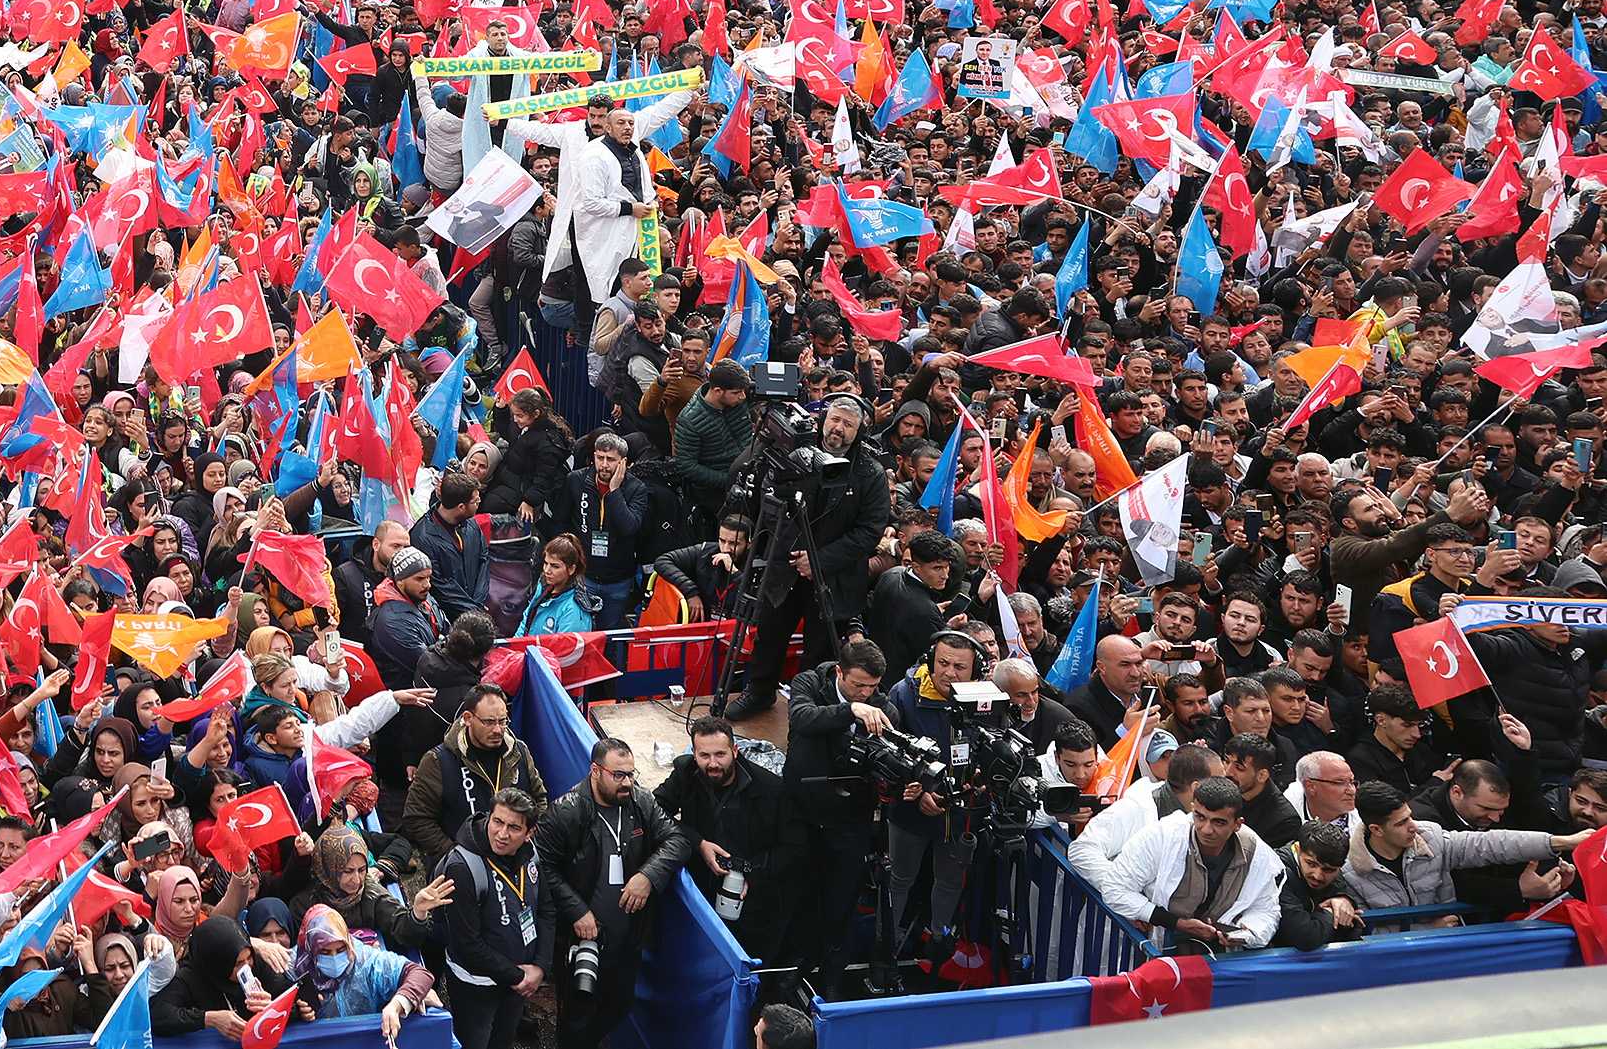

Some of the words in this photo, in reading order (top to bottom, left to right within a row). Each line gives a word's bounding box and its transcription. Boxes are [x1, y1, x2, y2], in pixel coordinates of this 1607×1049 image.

[424, 59, 494, 74] BAŞKAN
[499, 53, 586, 70] BEYAZGÜL
[1354, 70, 1404, 87] MUSTAFA
[498, 92, 579, 115] BAŞKAN
[580, 492, 589, 533] POLİS
[1505, 600, 1607, 624] SİVER
